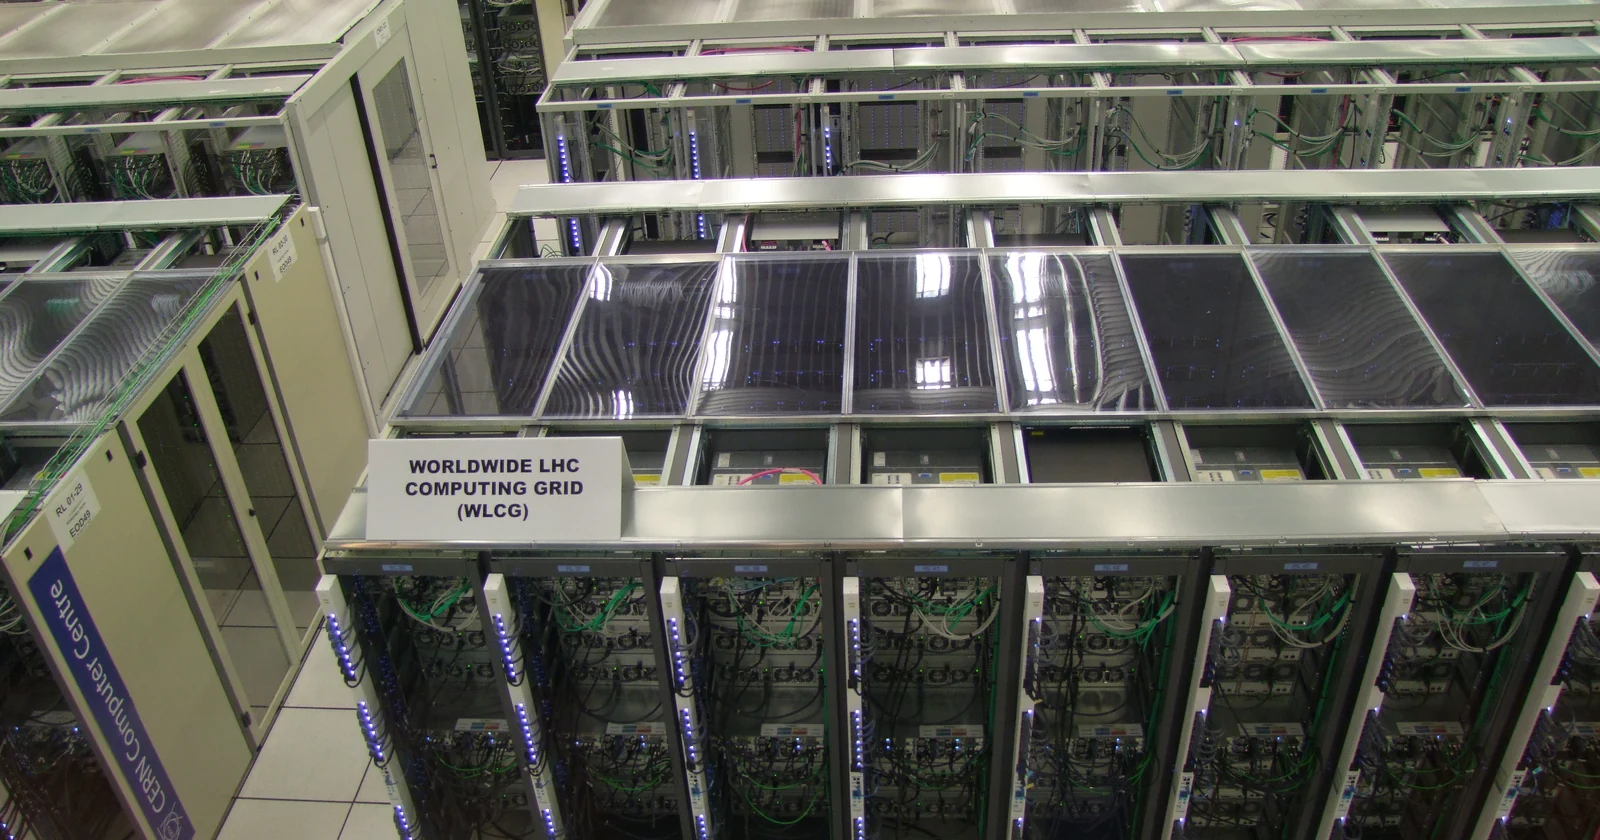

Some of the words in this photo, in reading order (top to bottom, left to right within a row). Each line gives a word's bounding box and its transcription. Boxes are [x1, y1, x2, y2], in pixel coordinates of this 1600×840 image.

[409, 459, 532, 474] WORLDWIDE
[539, 458, 580, 473] LHC
[55, 504, 68, 518] RL
[66, 482, 83, 506] 01-29
[405, 481, 527, 496] COMPUTING
[533, 480, 584, 495] GRID
[457, 503, 529, 522] (WLCG)
[50, 578, 91, 660] Centre
[86, 656, 141, 762] Computer
[135, 754, 166, 814] CERN
